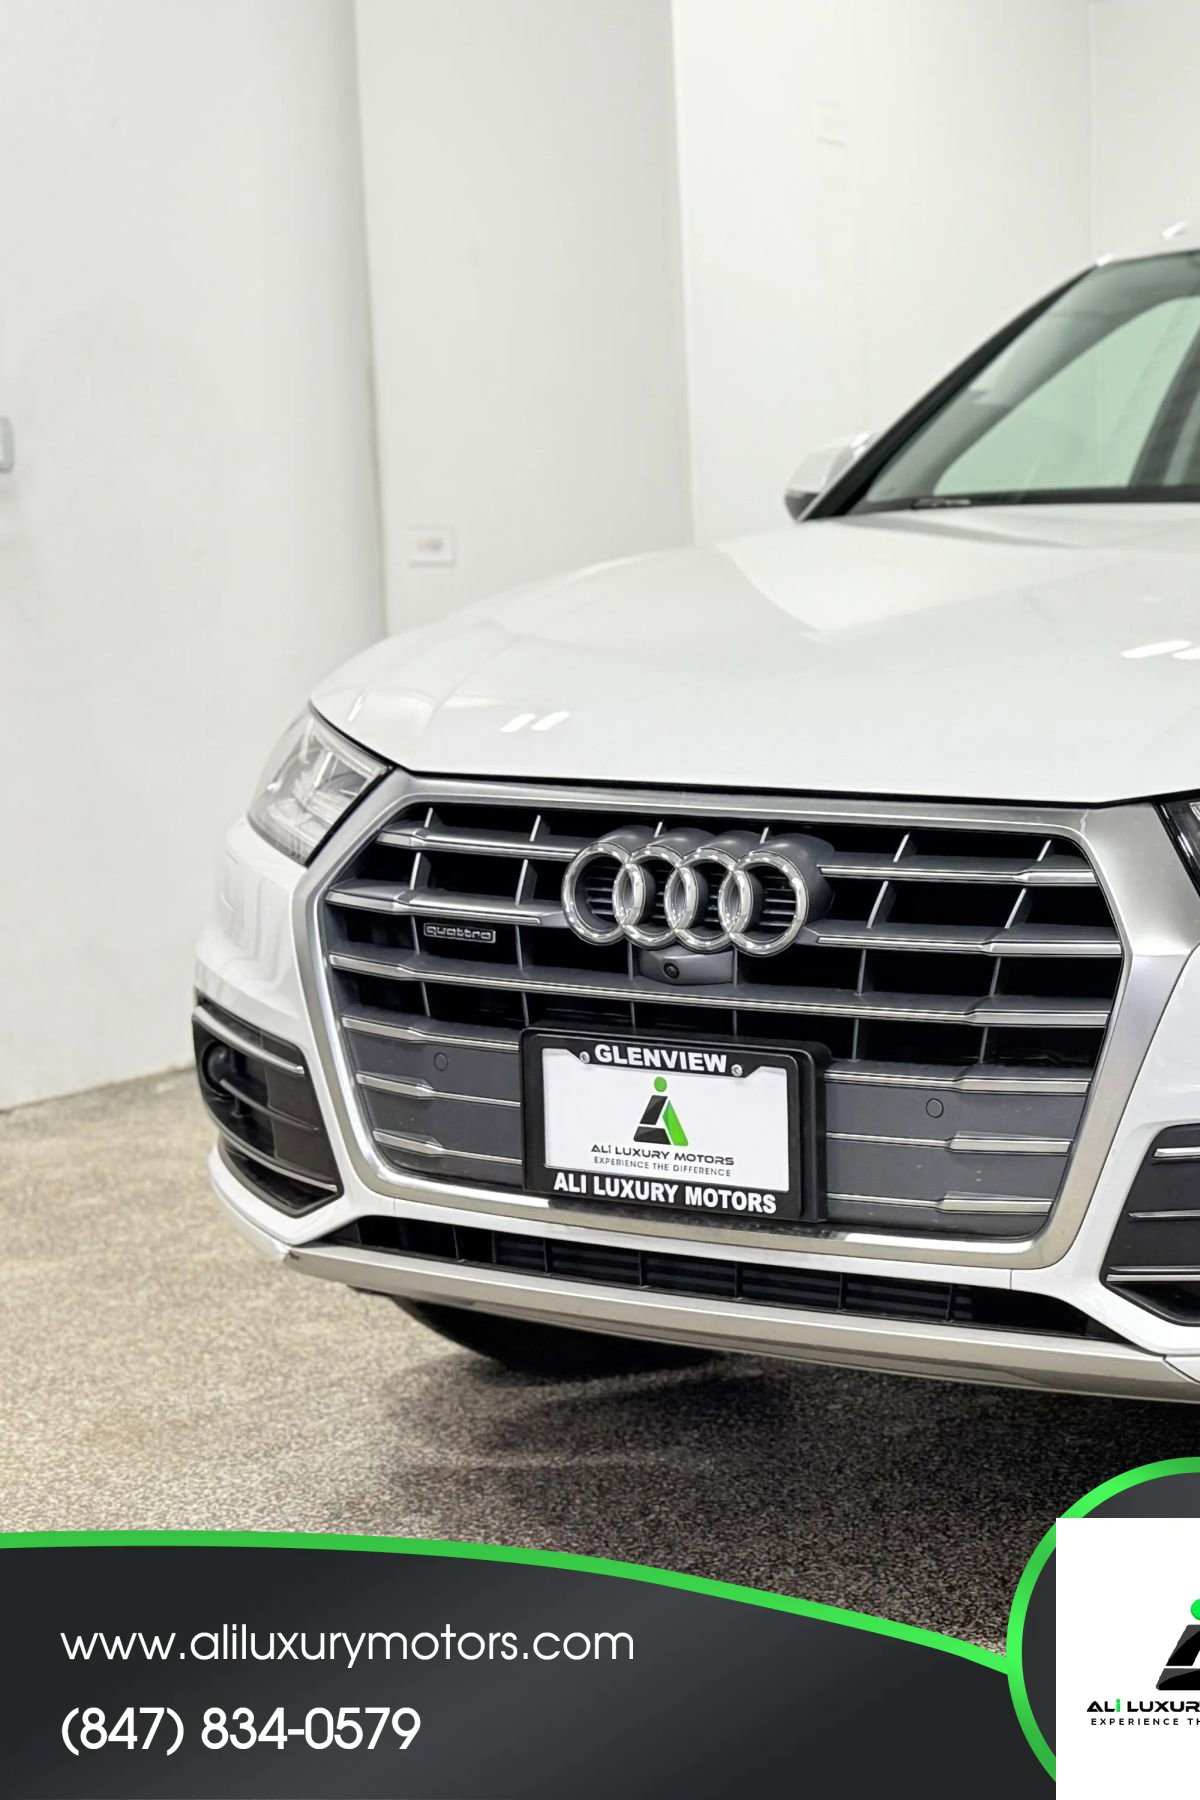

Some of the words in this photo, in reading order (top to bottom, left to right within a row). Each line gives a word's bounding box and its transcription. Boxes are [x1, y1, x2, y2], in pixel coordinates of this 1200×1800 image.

[426, 925, 492, 940] quattro
[594, 1044, 727, 1073] GLENVIEW
[594, 1156, 650, 1170] EXPERIENCE
[652, 1162, 669, 1172] THE
[672, 1164, 732, 1177] DIFFERENCE
[614, 1147, 671, 1160] LUXURY
[673, 1152, 735, 1166] MOTORS
[553, 1172, 587, 1194] ALI
[593, 1175, 679, 1204] LUXURY
[684, 1186, 777, 1214] MOTORS
